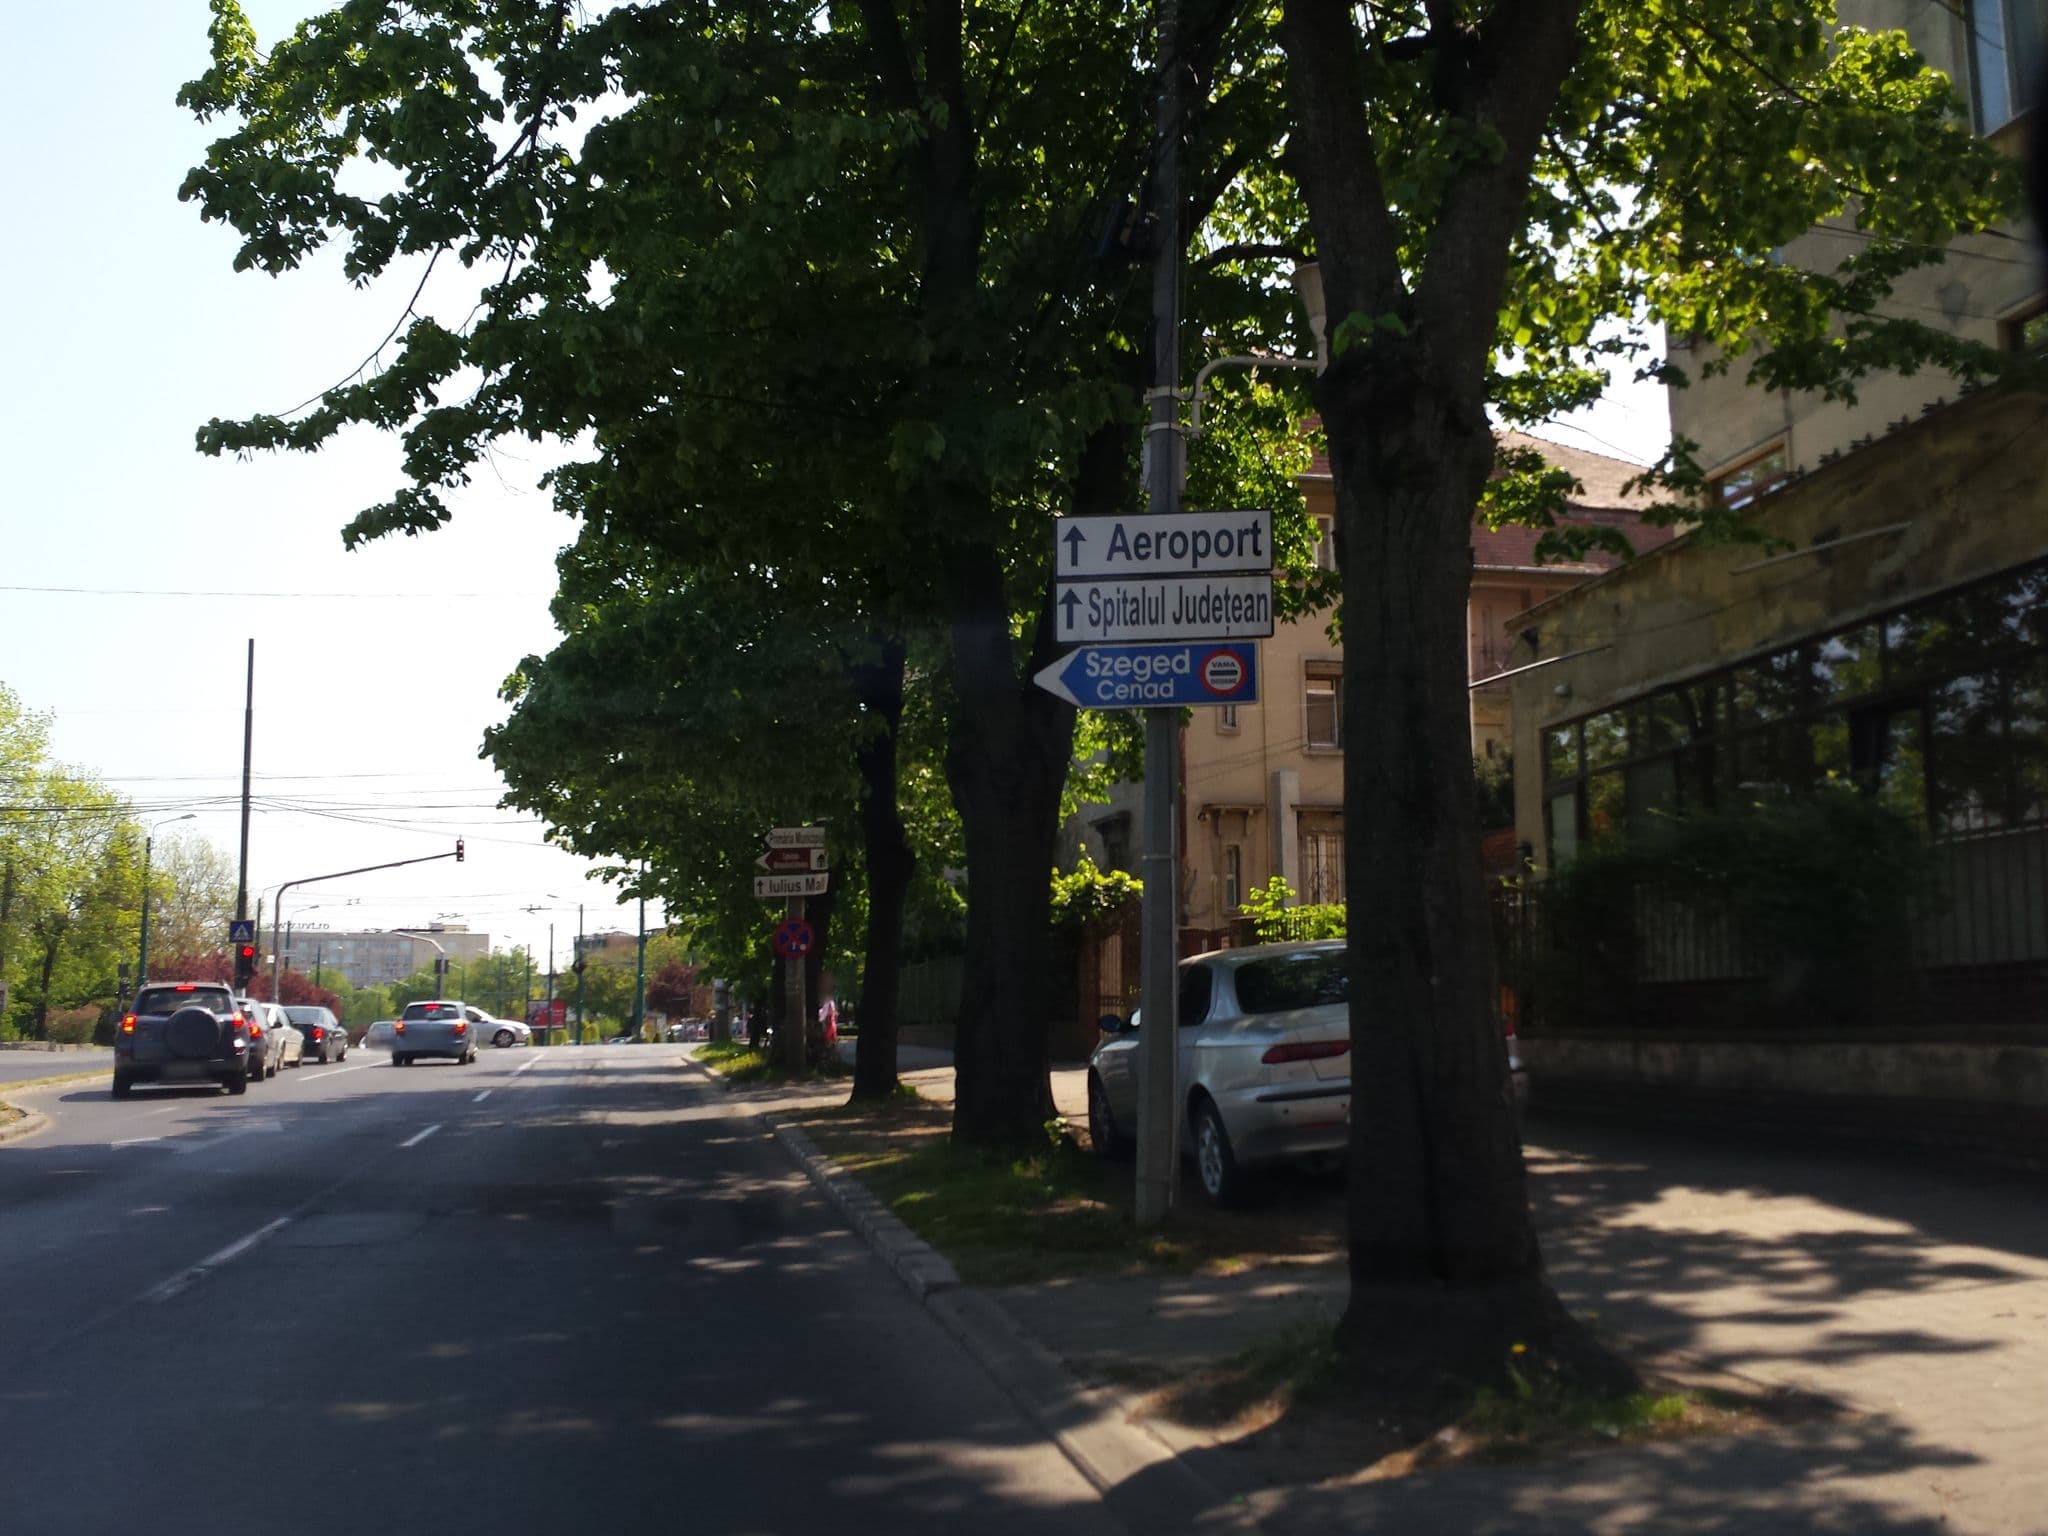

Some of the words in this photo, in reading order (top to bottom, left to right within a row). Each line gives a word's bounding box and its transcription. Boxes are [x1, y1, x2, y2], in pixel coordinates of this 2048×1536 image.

[1106, 519, 1262, 568] Aeroport
[1088, 585, 1165, 637] Spitalul
[1085, 649, 1190, 682] Szeged
[1096, 678, 1174, 701] Cenad
[769, 879, 801, 894] Iulius
